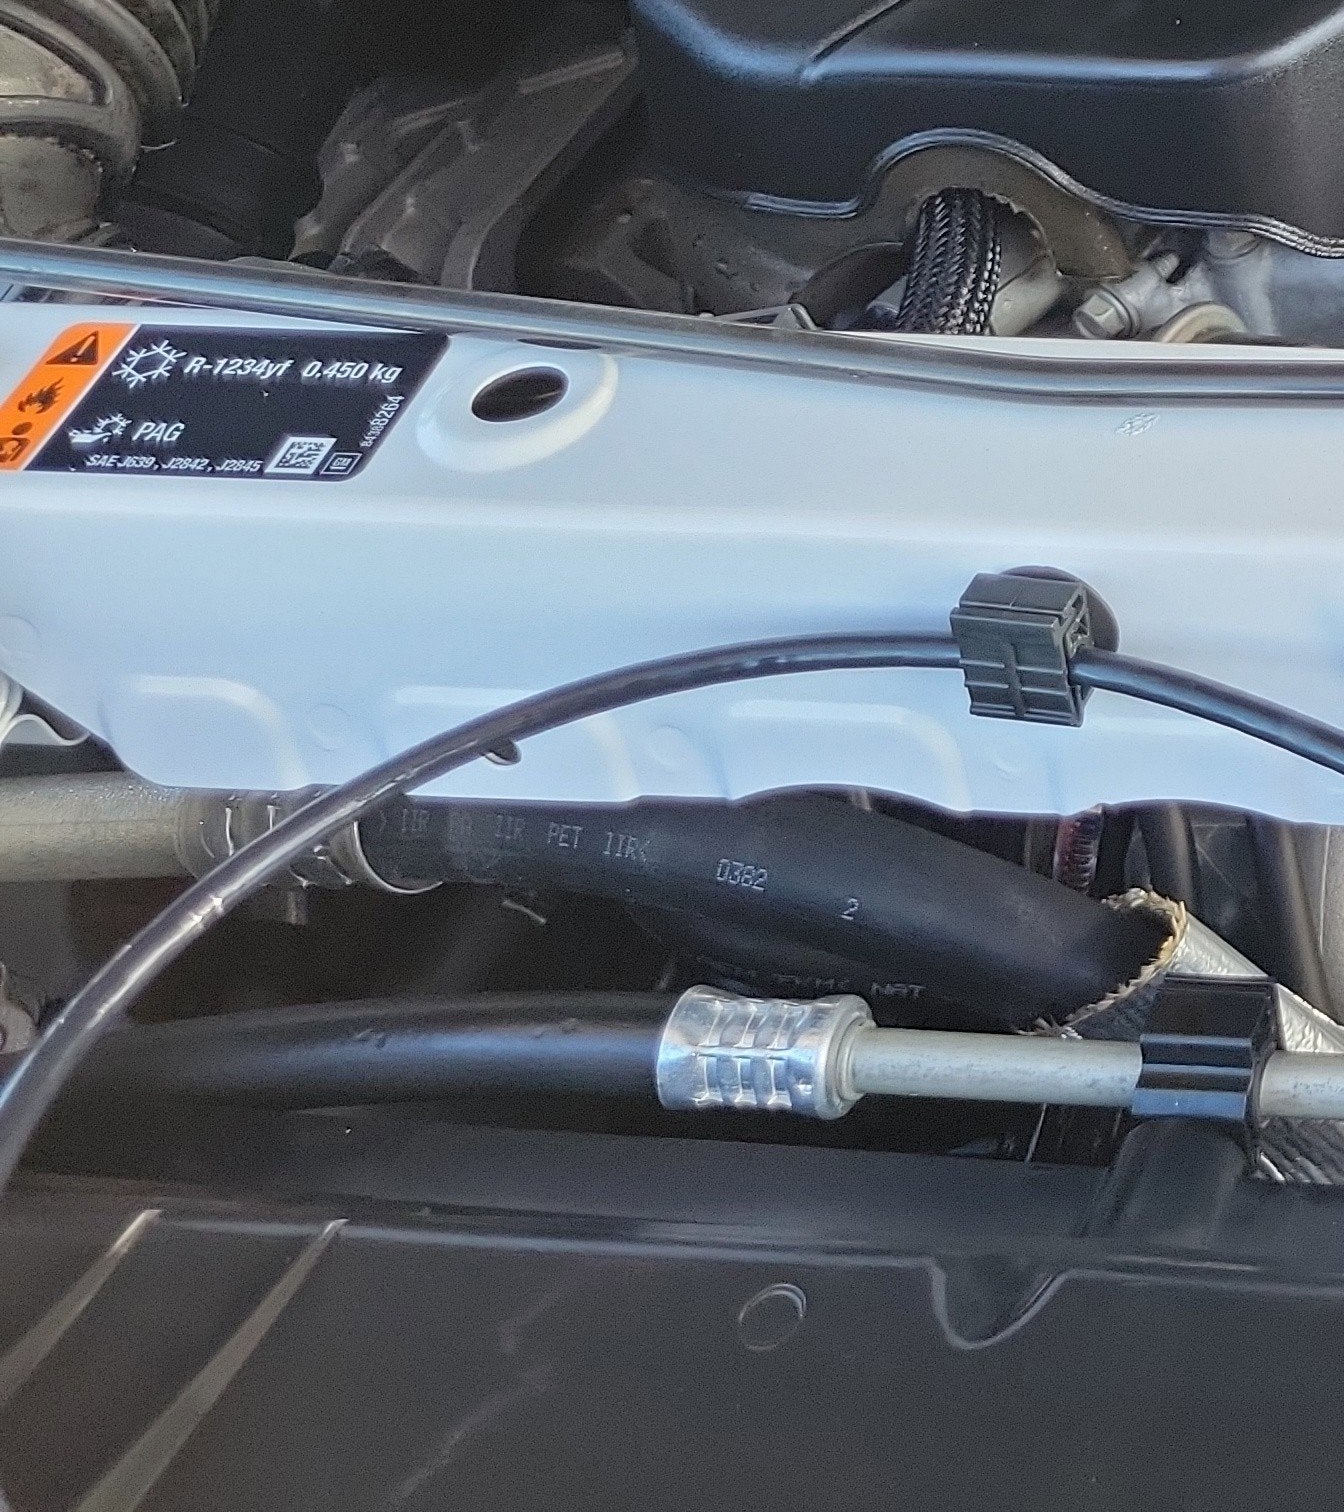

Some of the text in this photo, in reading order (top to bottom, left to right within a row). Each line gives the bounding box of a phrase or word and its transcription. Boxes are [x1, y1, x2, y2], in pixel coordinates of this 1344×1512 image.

[184, 357, 403, 383] R-1234yf 0.450 kg
[133, 422, 186, 444] PAG
[86, 454, 119, 467] SAE
[215, 459, 264, 473] J2845
[547, 821, 583, 849] PET
